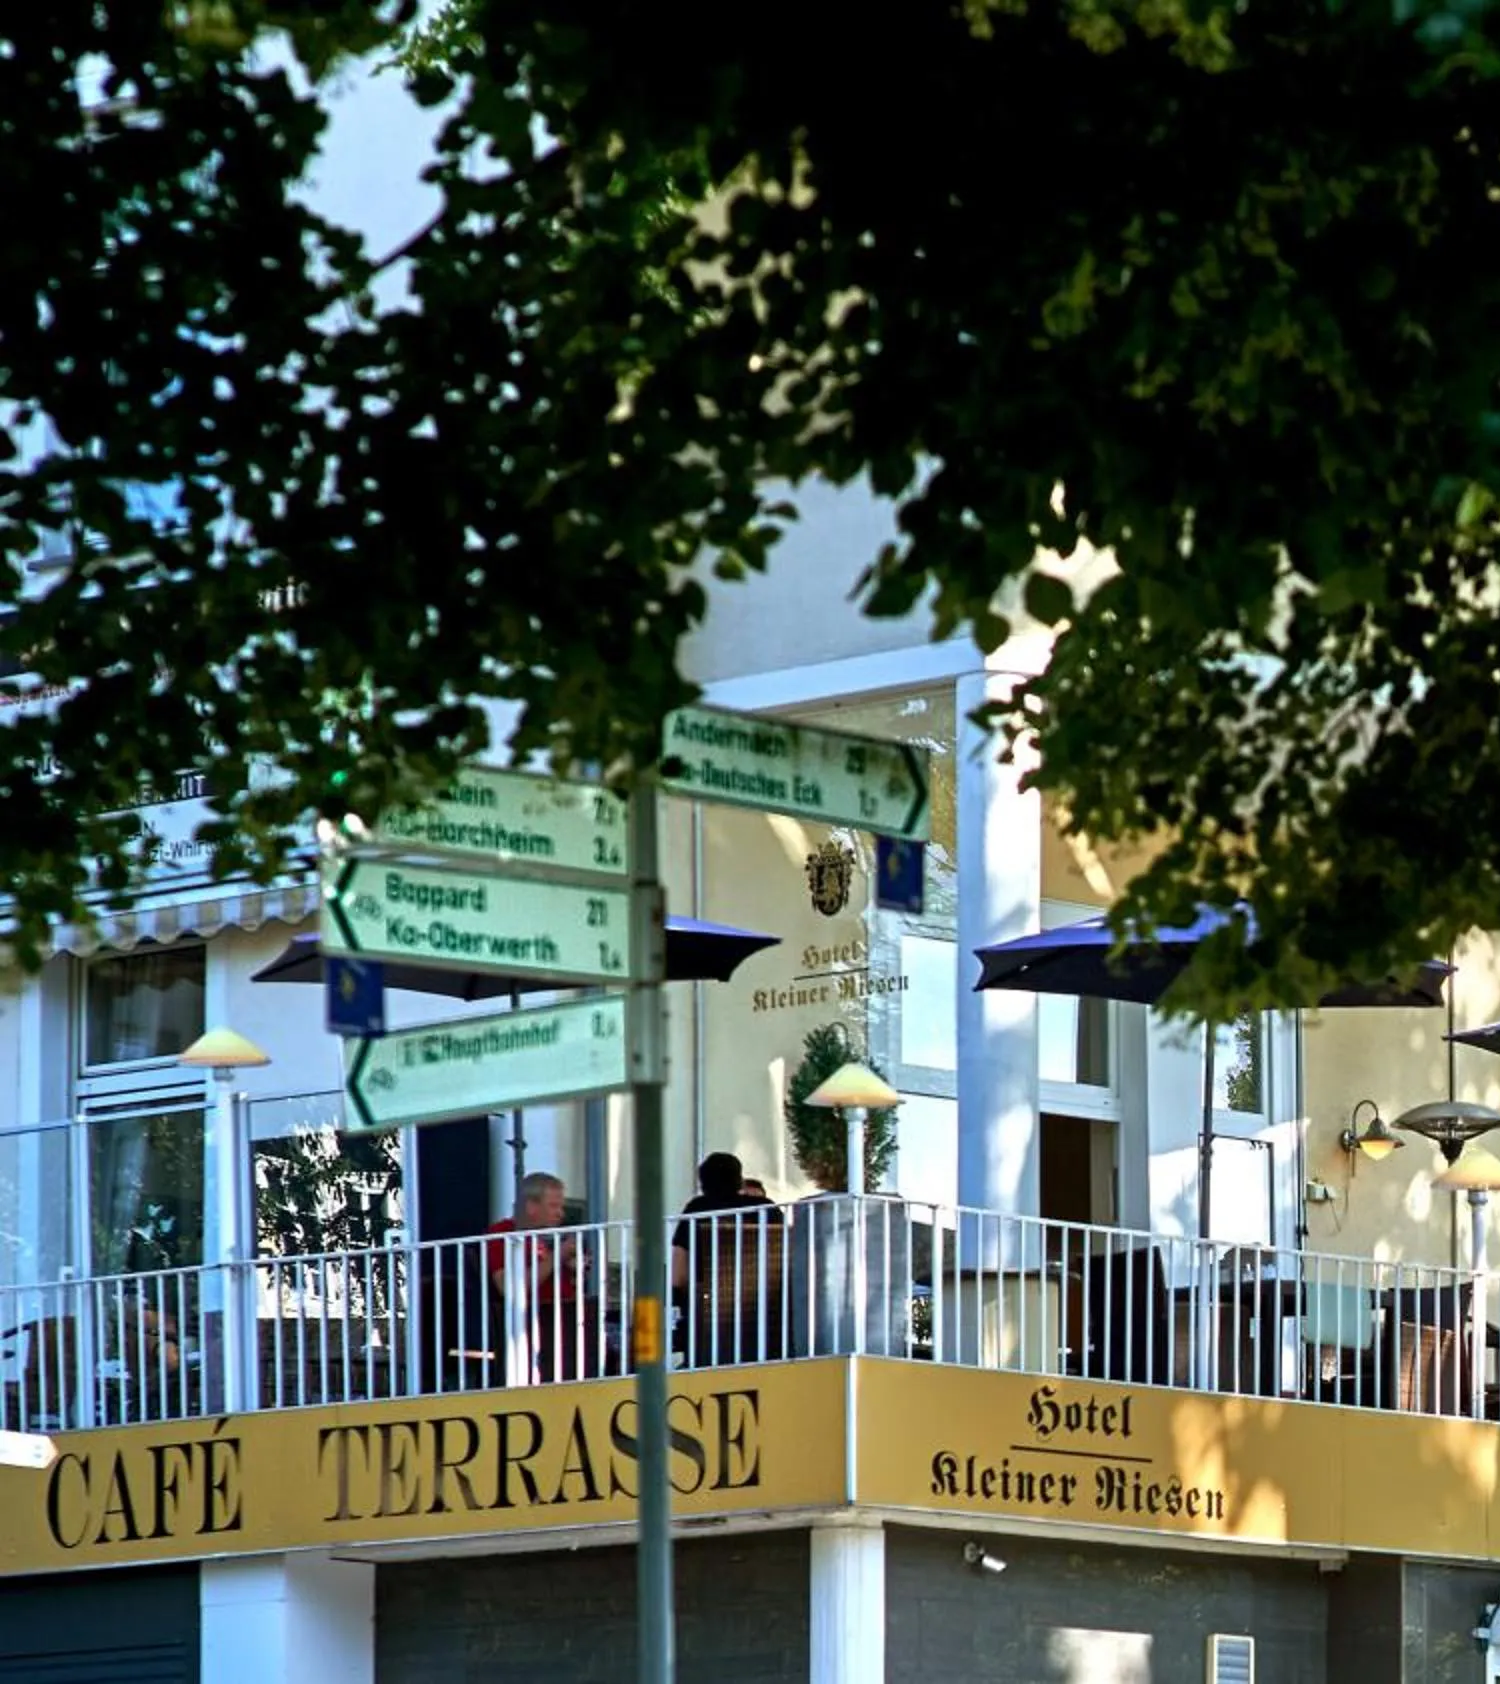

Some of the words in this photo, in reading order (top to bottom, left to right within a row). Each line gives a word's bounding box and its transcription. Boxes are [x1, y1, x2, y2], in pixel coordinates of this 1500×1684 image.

[672, 713, 788, 758] Andernach
[672, 757, 789, 800] o-Deutsches
[793, 775, 823, 807] Eck
[386, 872, 487, 912] Boppard
[386, 918, 559, 962] Ko-Oberwerth
[801, 939, 862, 970] Hotel
[752, 984, 830, 1013] Kleiner
[838, 974, 909, 1000] Riesen
[440, 1020, 560, 1064] Hauptbahnhof
[1026, 1384, 1133, 1440] Hotel
[46, 1416, 242, 1549] CAFÉ
[317, 1389, 761, 1523] TERRASSE
[930, 1450, 1077, 1507] Kleiner
[1094, 1465, 1225, 1522] Riesen
